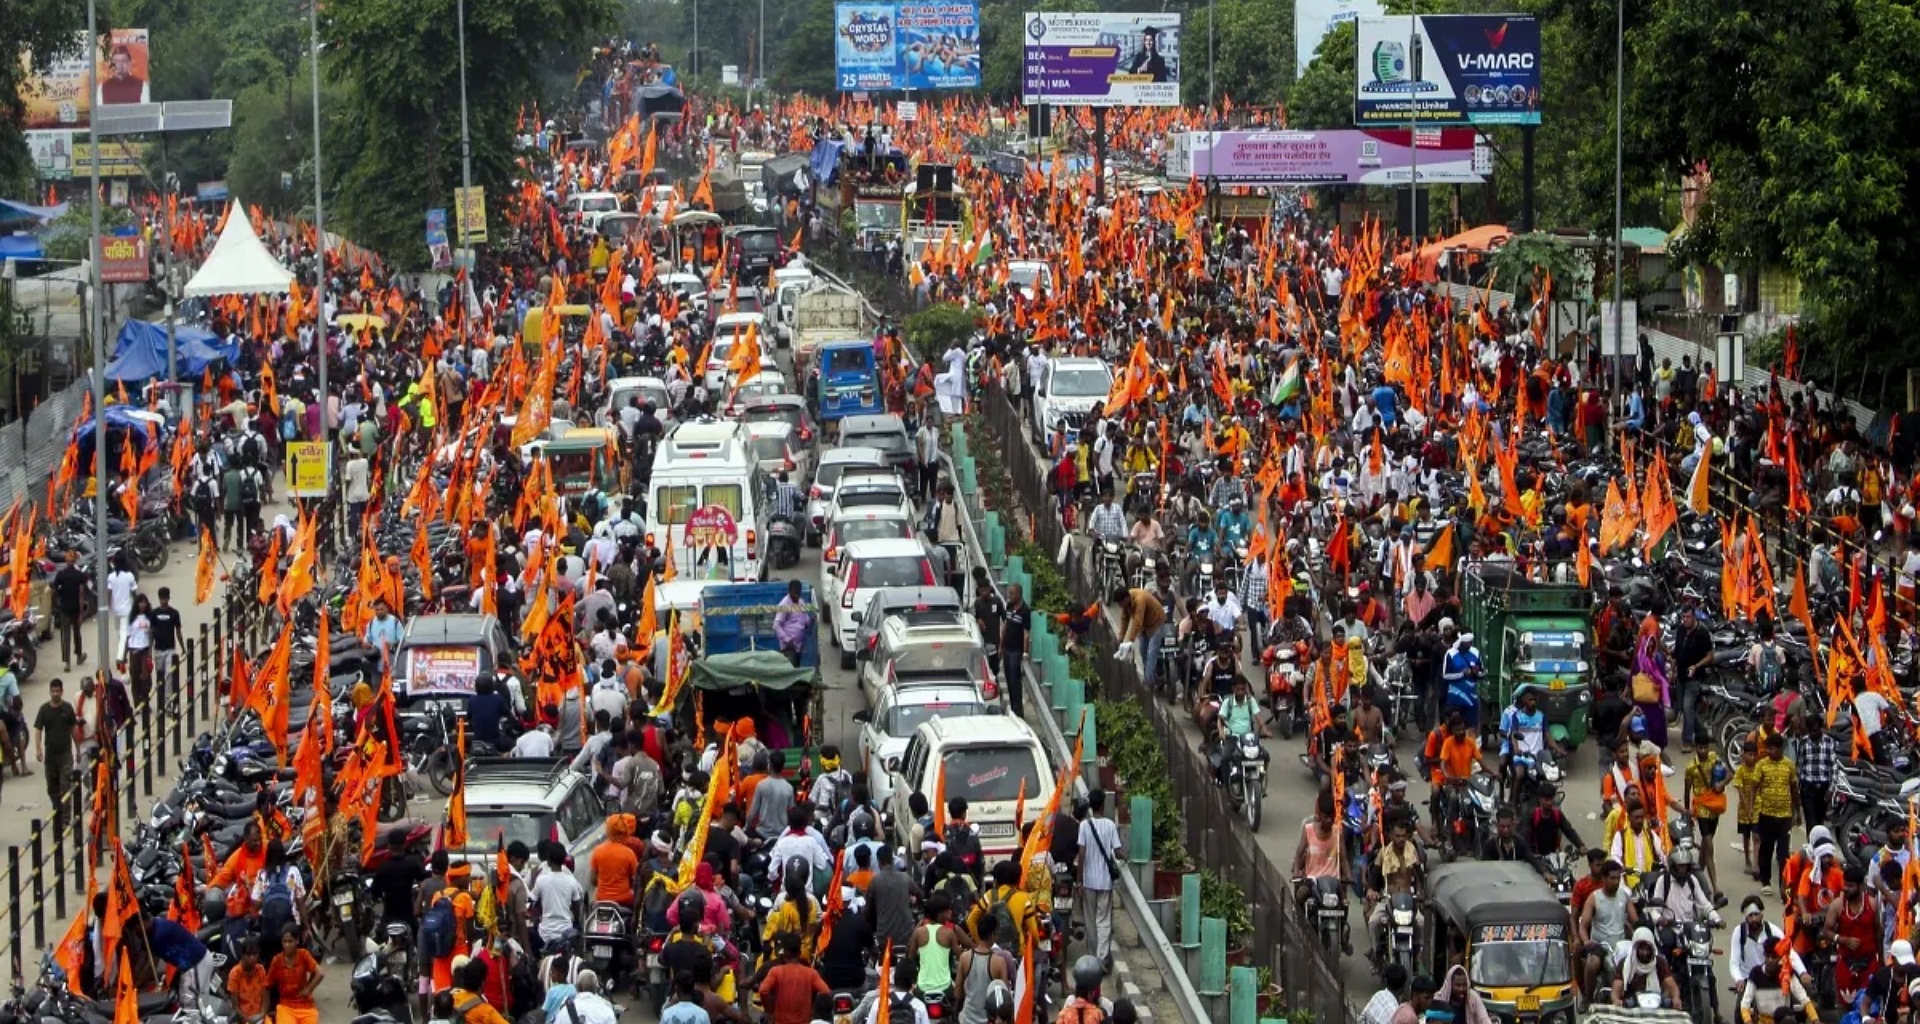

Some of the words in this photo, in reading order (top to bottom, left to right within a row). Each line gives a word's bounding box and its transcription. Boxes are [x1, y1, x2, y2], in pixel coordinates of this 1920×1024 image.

[1048, 18, 1101, 27] MOTHERHOOD
[849, 23, 888, 34] CRYSTAL
[854, 33, 887, 44] WORLD
[1457, 53, 1534, 70] V-MARC
[842, 74, 857, 88] 25
